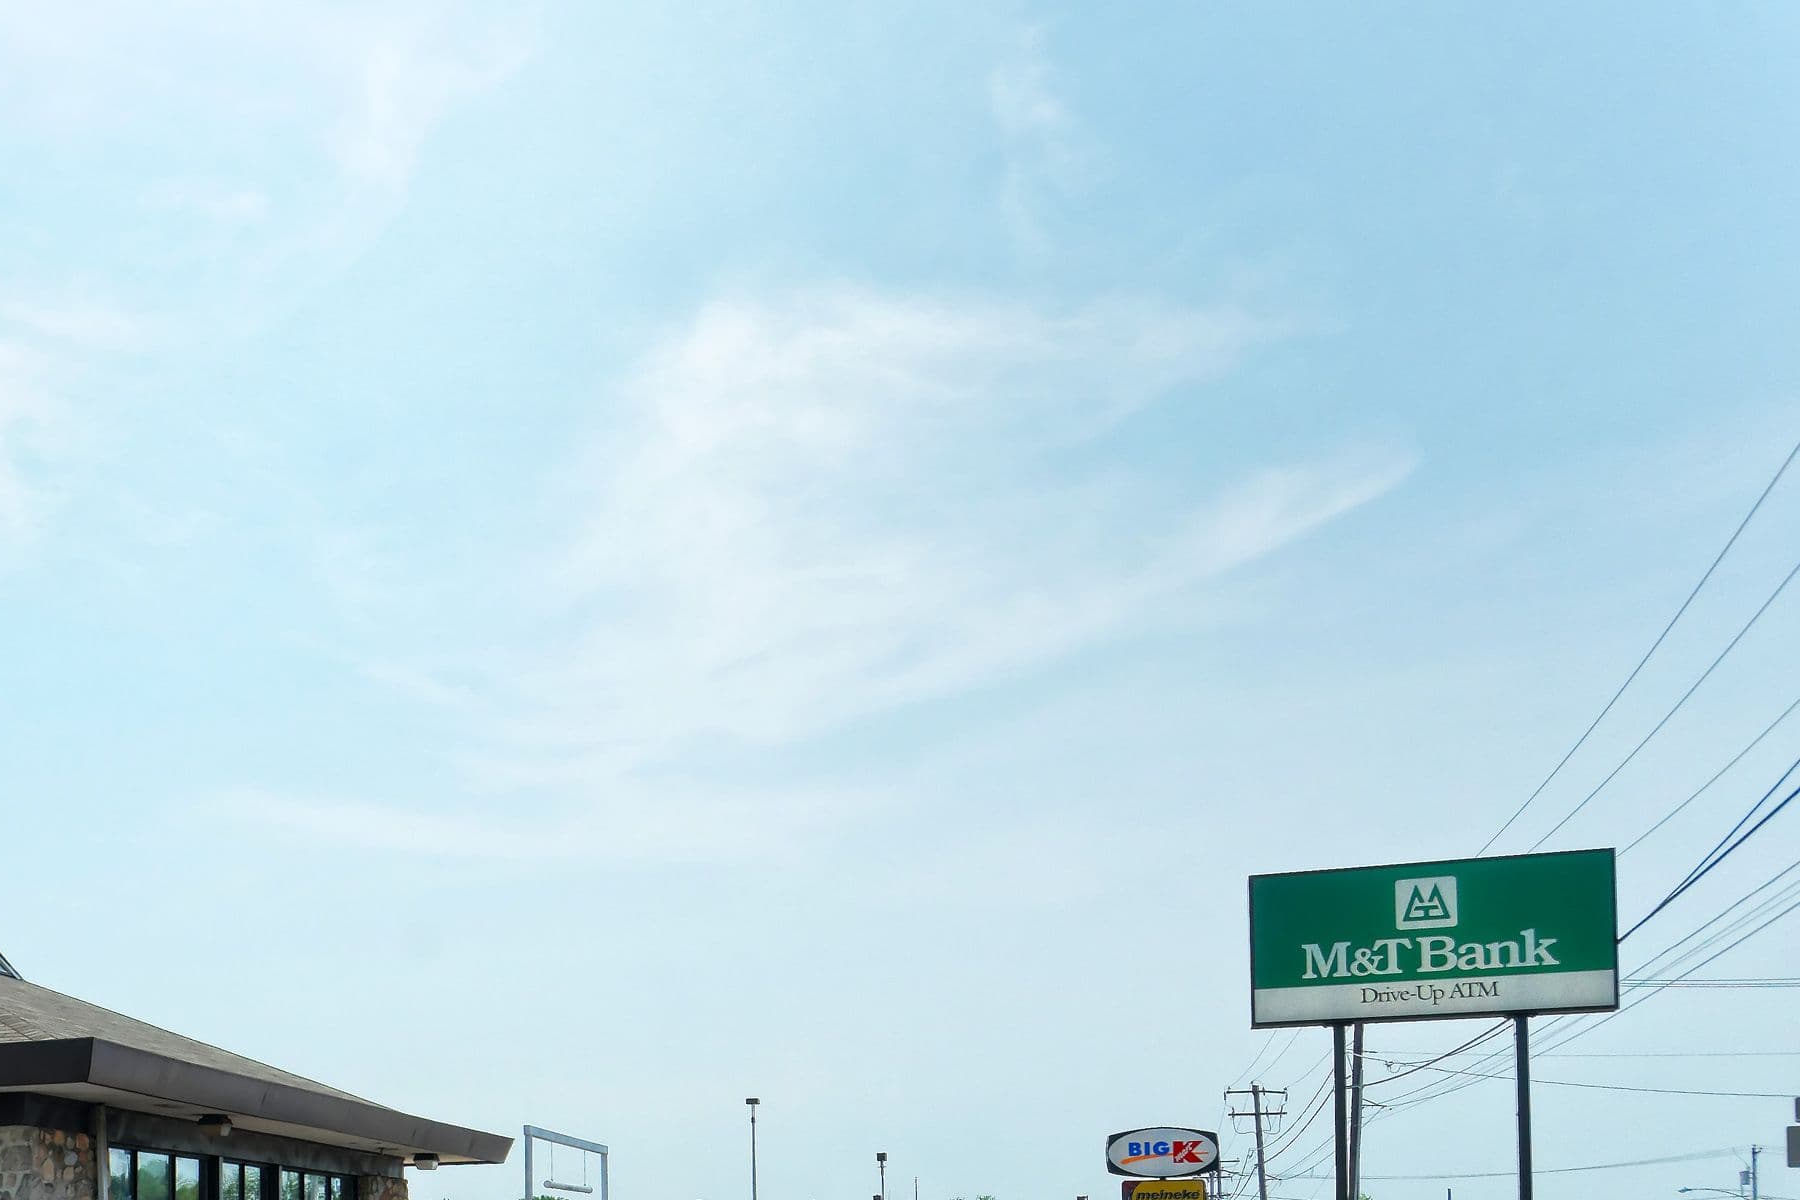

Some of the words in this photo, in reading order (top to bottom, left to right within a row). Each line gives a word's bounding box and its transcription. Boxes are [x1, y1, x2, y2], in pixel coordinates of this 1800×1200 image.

[1300, 938, 1413, 979] M&T
[1416, 927, 1561, 974] Bank
[1360, 984, 1445, 1005] Drive-Up
[1449, 980, 1501, 999] ATM
[1128, 1141, 1170, 1157] BIG
[1136, 1189, 1200, 1200] meineke
